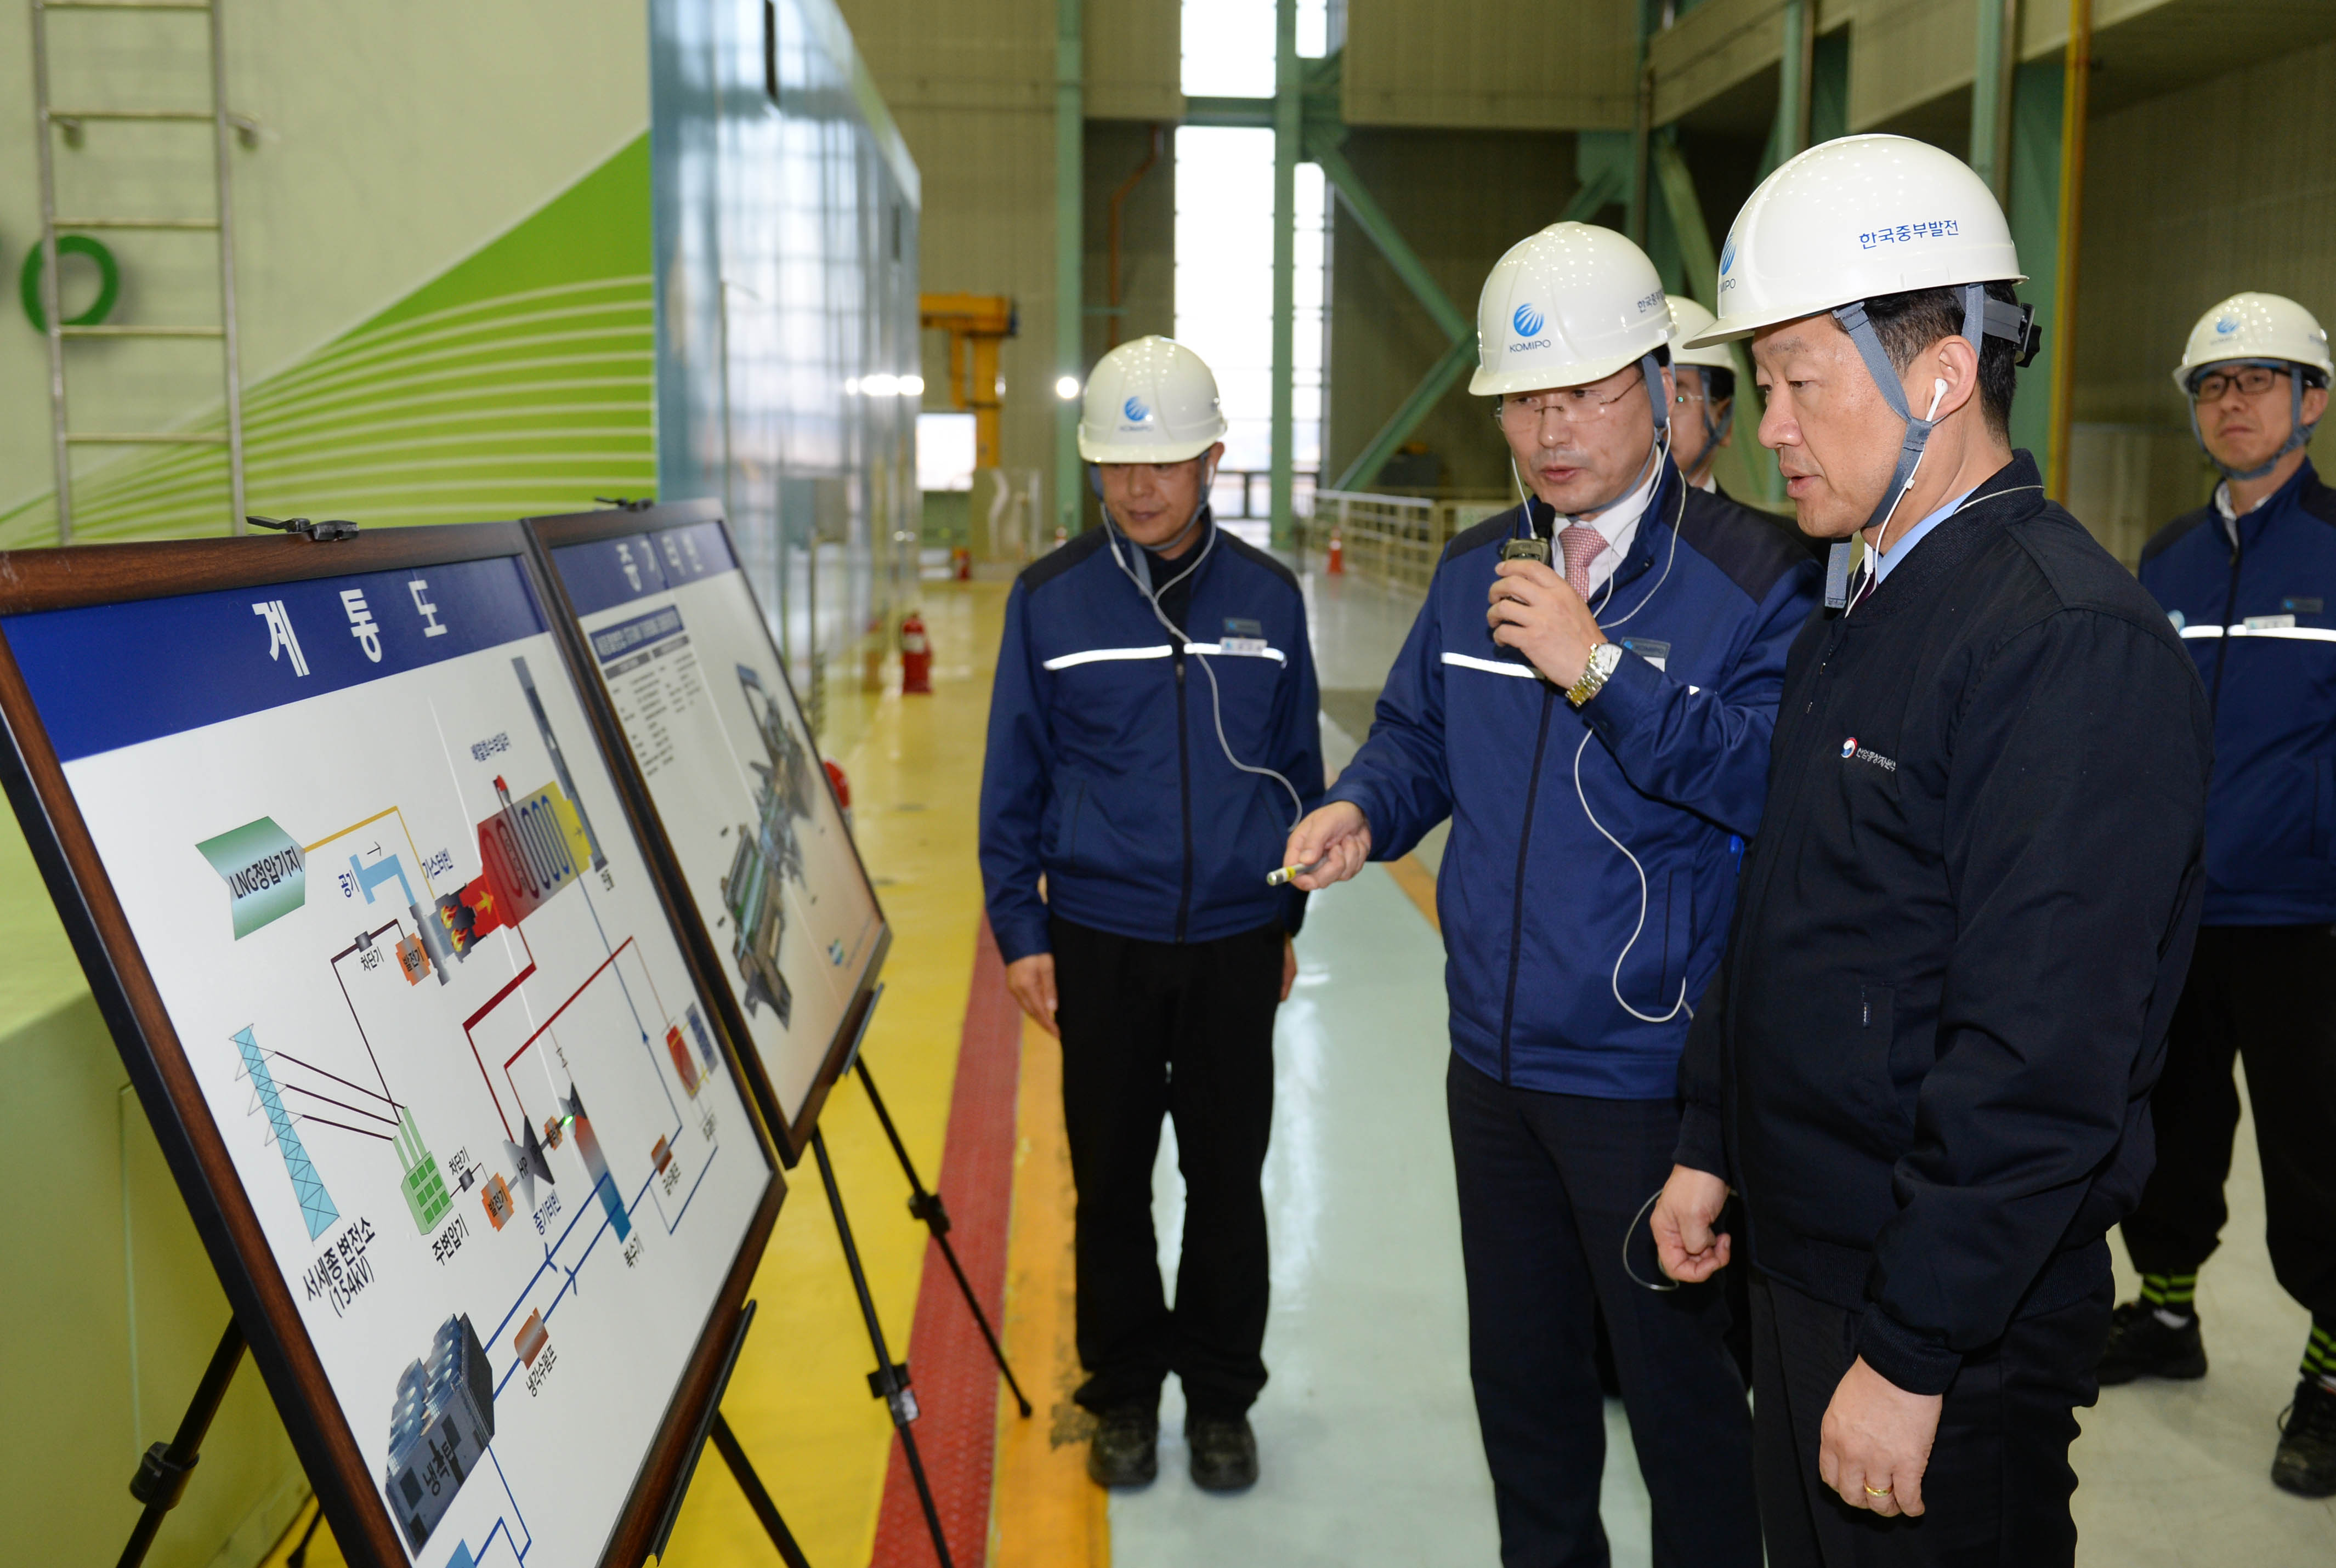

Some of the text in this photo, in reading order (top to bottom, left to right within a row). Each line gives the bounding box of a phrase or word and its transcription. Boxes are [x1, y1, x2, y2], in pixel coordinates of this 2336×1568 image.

[1858, 220, 1959, 249] 한국중부발전
[1509, 339, 1551, 353] KOMIPO
[229, 846, 303, 899] LNG정압기지
[422, 848, 453, 880] 가스터빈
[338, 870, 360, 898] 공기
[360, 946, 384, 972] 차단기
[402, 947, 424, 972] 발전기
[449, 1146, 470, 1176] 차단기
[517, 1156, 529, 1180] HP
[487, 1186, 508, 1218] 발전기
[533, 1189, 562, 1235] 증기터빈
[432, 1213, 469, 1266] 주변압기
[329, 1255, 375, 1319] (154kV)
[525, 1344, 558, 1397] 냉각수펌프
